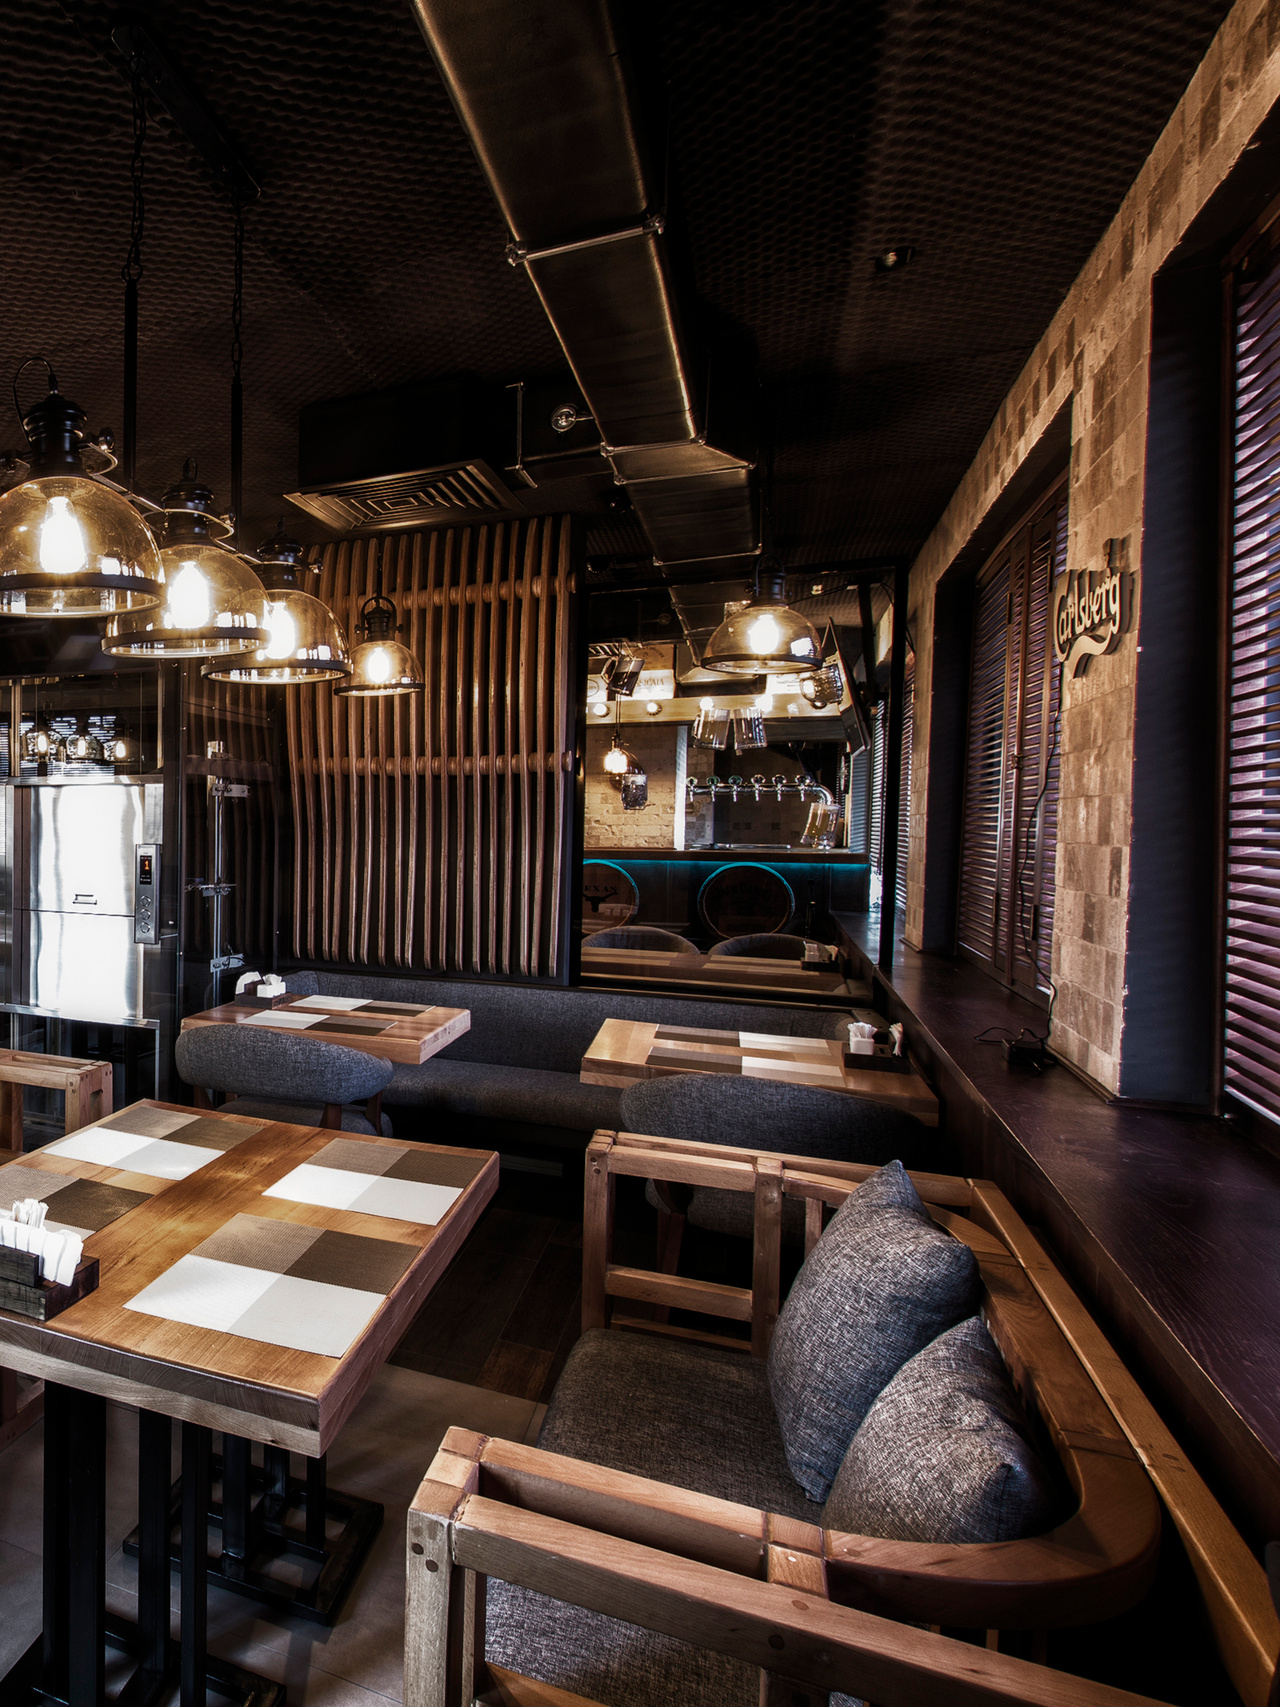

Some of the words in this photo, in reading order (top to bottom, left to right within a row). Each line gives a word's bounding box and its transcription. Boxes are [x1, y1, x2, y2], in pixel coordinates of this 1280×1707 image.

[1053, 566, 1122, 679] Carlsberg
[144, 860, 150, 870] 1
[584, 884, 618, 892] EXAS
